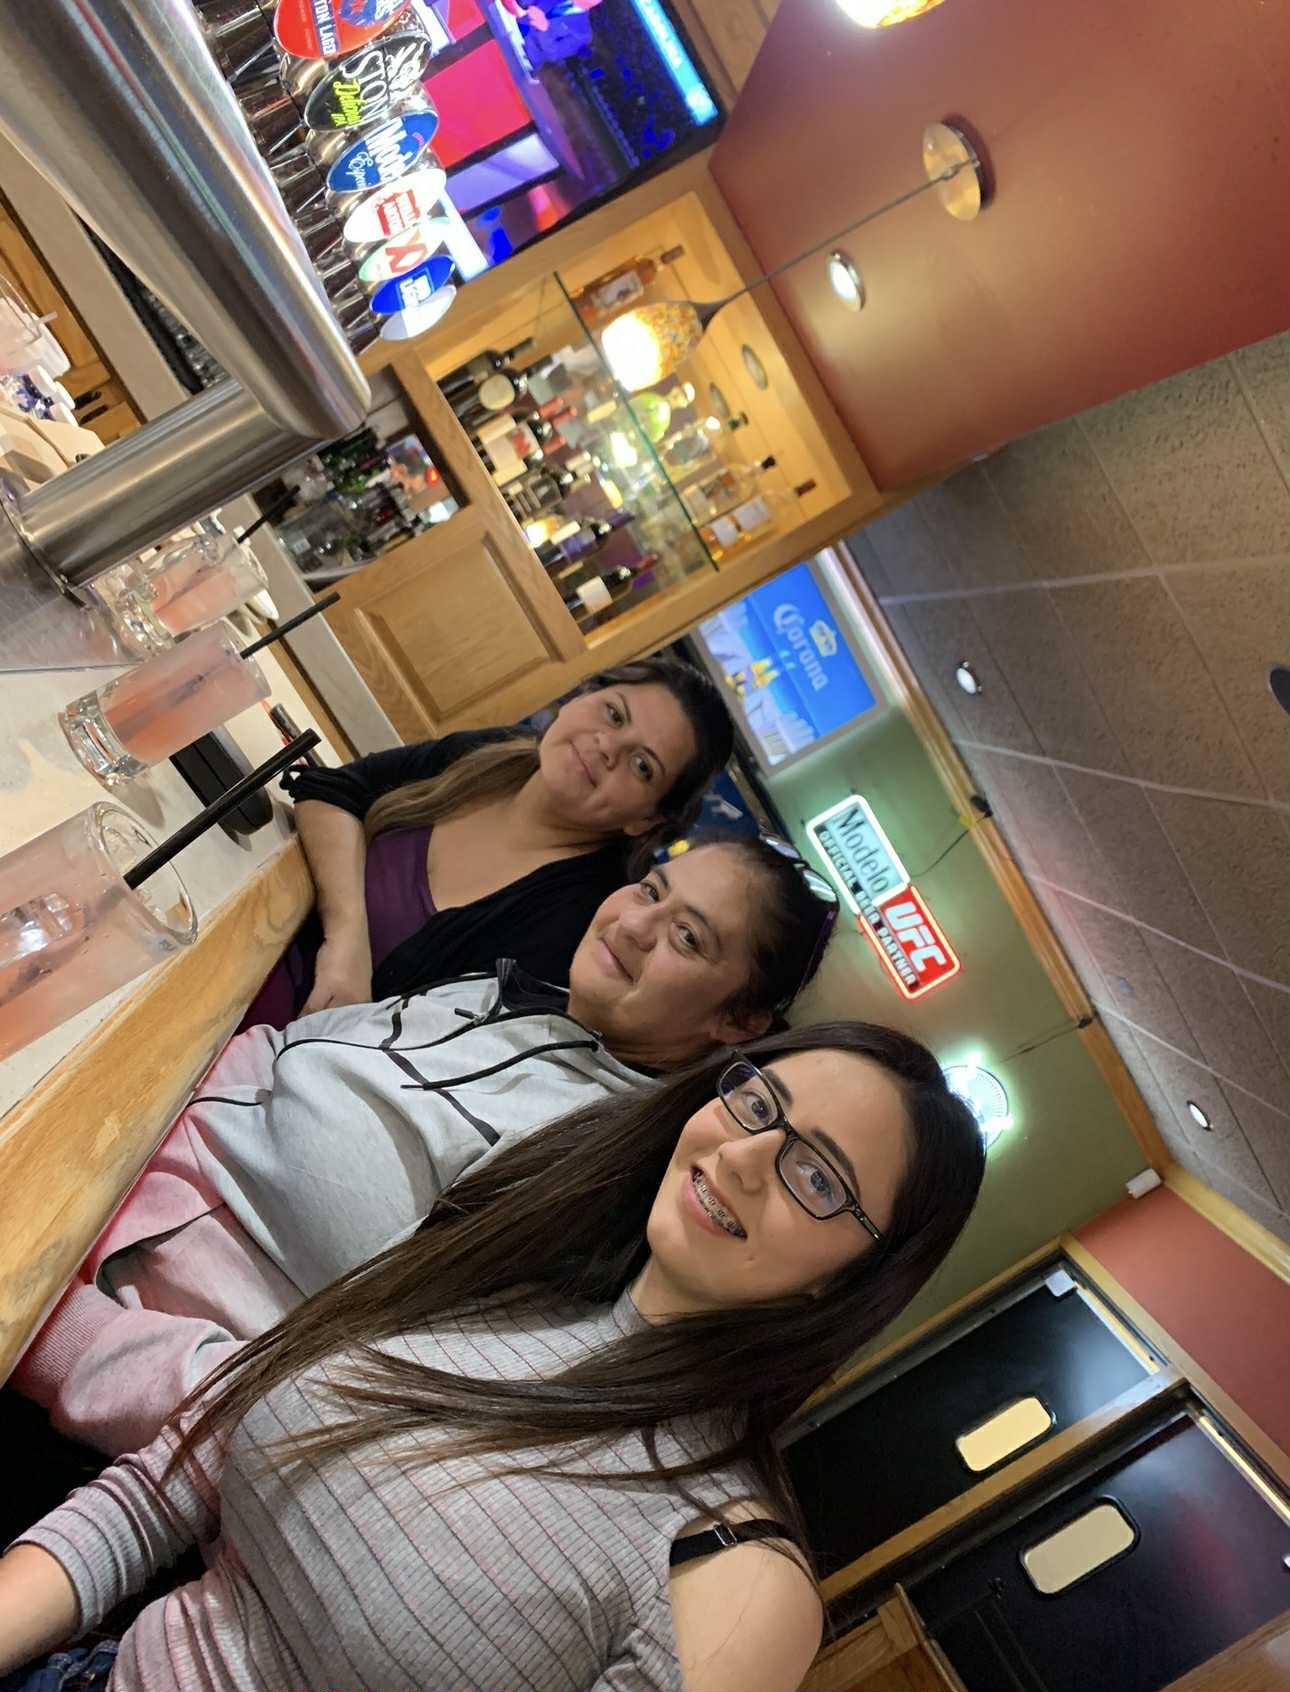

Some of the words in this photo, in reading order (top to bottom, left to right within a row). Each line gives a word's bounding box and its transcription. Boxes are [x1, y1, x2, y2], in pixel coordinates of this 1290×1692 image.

[773, 603, 829, 691] Corona
[834, 806, 891, 895] Modelo
[818, 829, 858, 887] OFFICIAL
[855, 890, 880, 925] BEER
[877, 928, 917, 985] PARTNER
[884, 901, 947, 973] UFC
